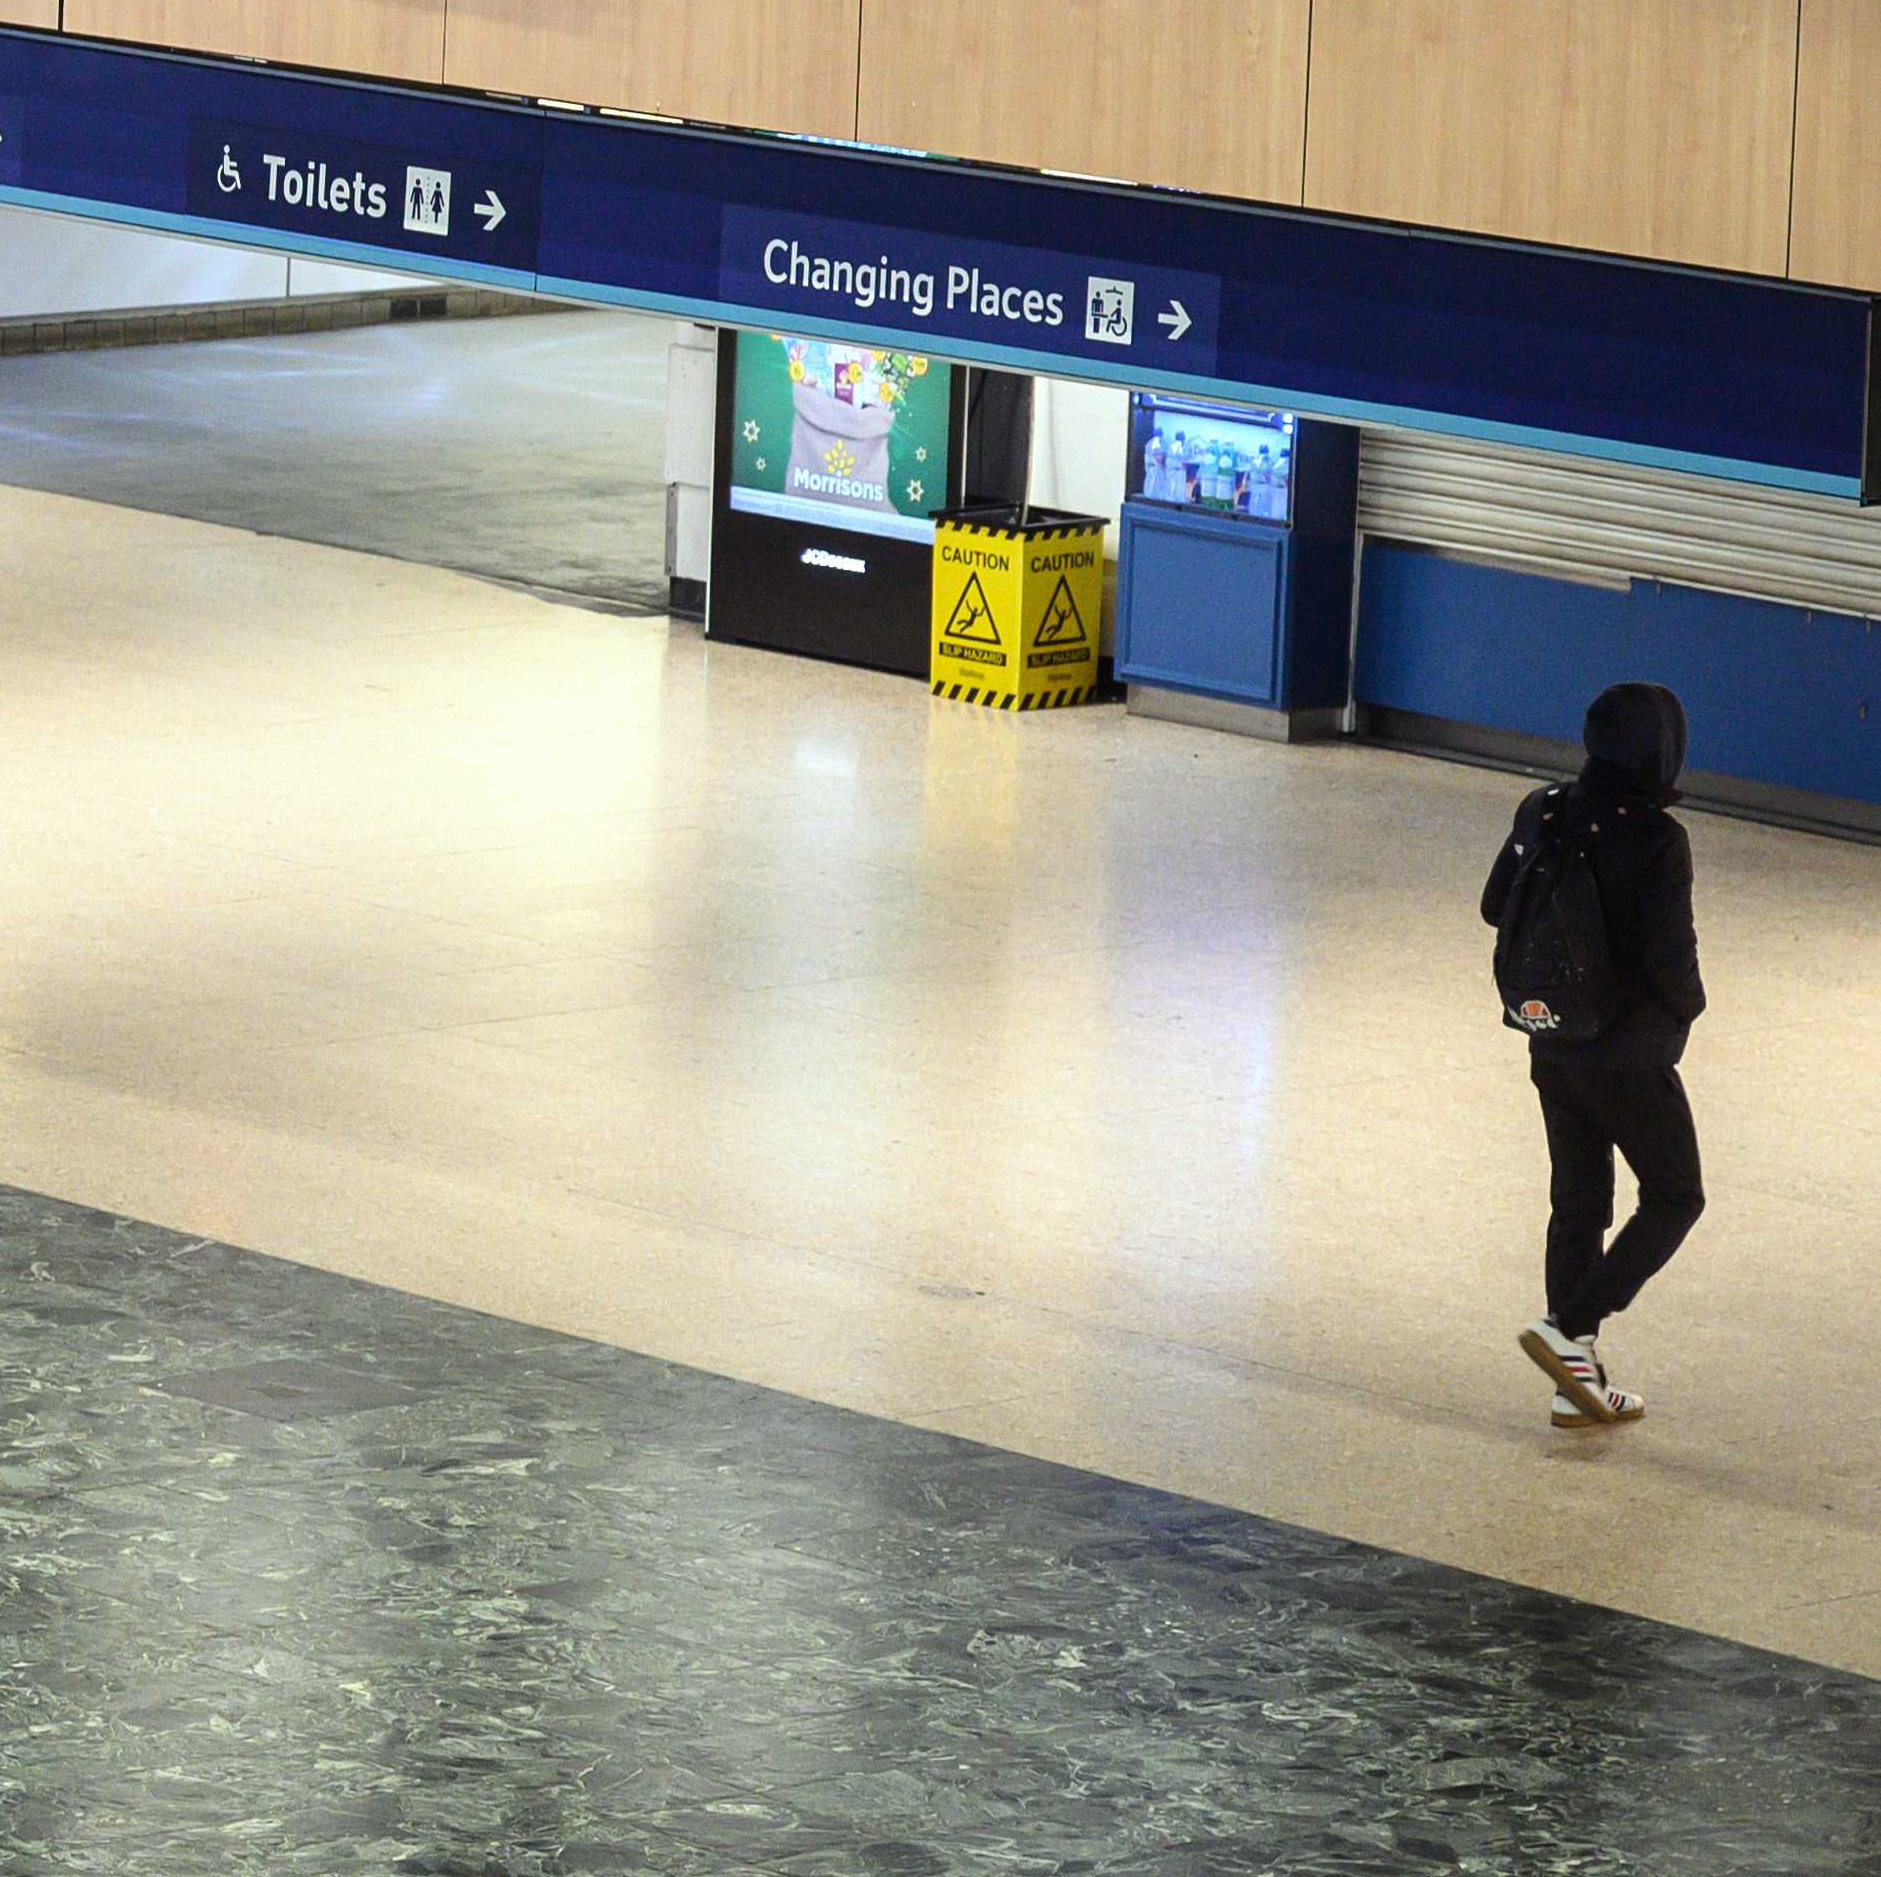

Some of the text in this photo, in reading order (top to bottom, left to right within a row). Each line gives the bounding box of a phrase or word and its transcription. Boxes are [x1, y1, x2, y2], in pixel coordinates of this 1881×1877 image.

[262, 153, 388, 220] Toilets
[762, 238, 1065, 325] Changing Places
[793, 466, 885, 502] Morrisons
[941, 545, 1010, 571] CAUTION
[1031, 550, 1095, 573] CAUTION
[942, 643, 1003, 665] SLIP HAZARD
[1031, 649, 1088, 666] SLIP HAZARD
